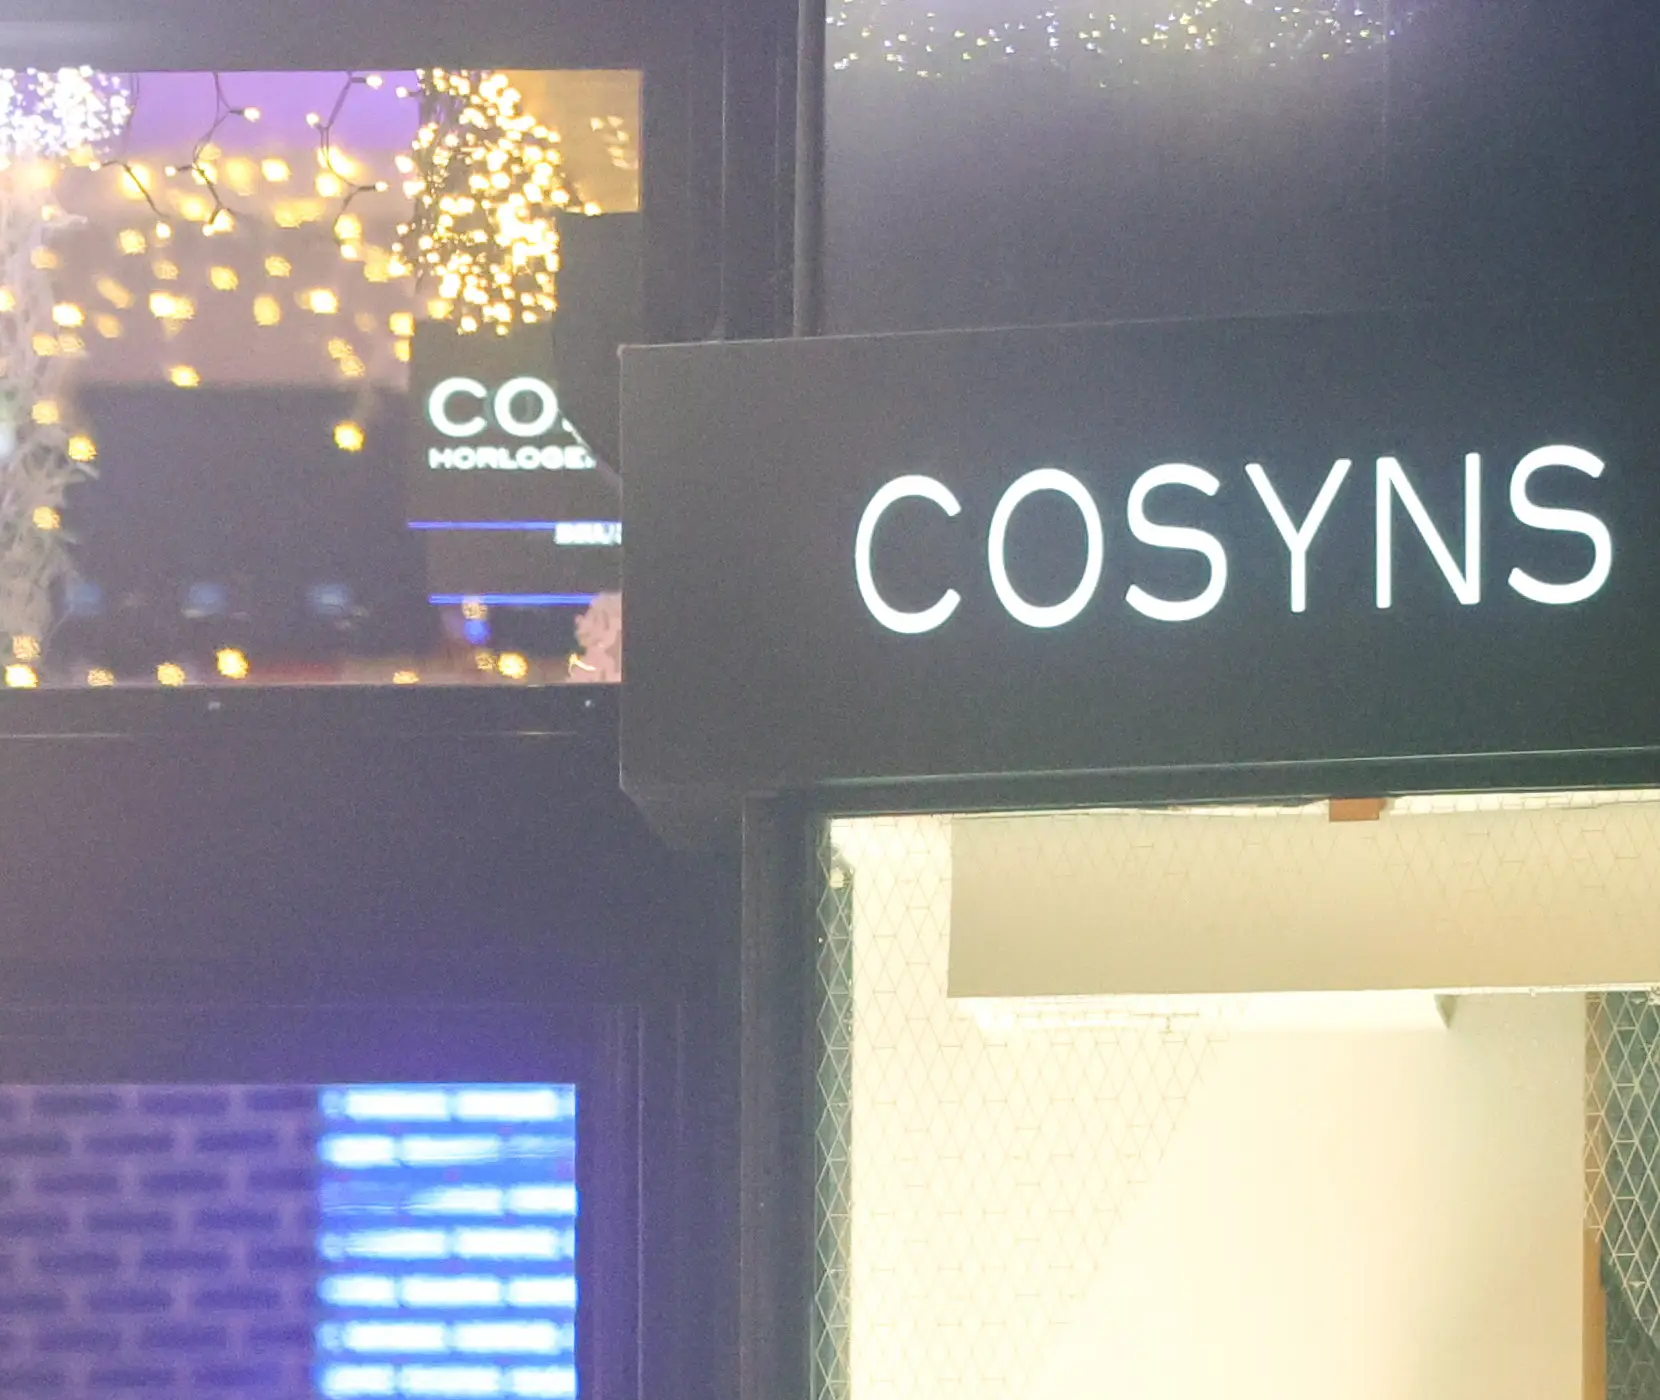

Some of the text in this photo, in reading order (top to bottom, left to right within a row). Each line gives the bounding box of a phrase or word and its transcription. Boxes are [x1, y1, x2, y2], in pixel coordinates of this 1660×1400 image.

[429, 376, 574, 437] CO
[428, 445, 597, 470] HORLOGE
[854, 444, 1613, 635] COSYNS
